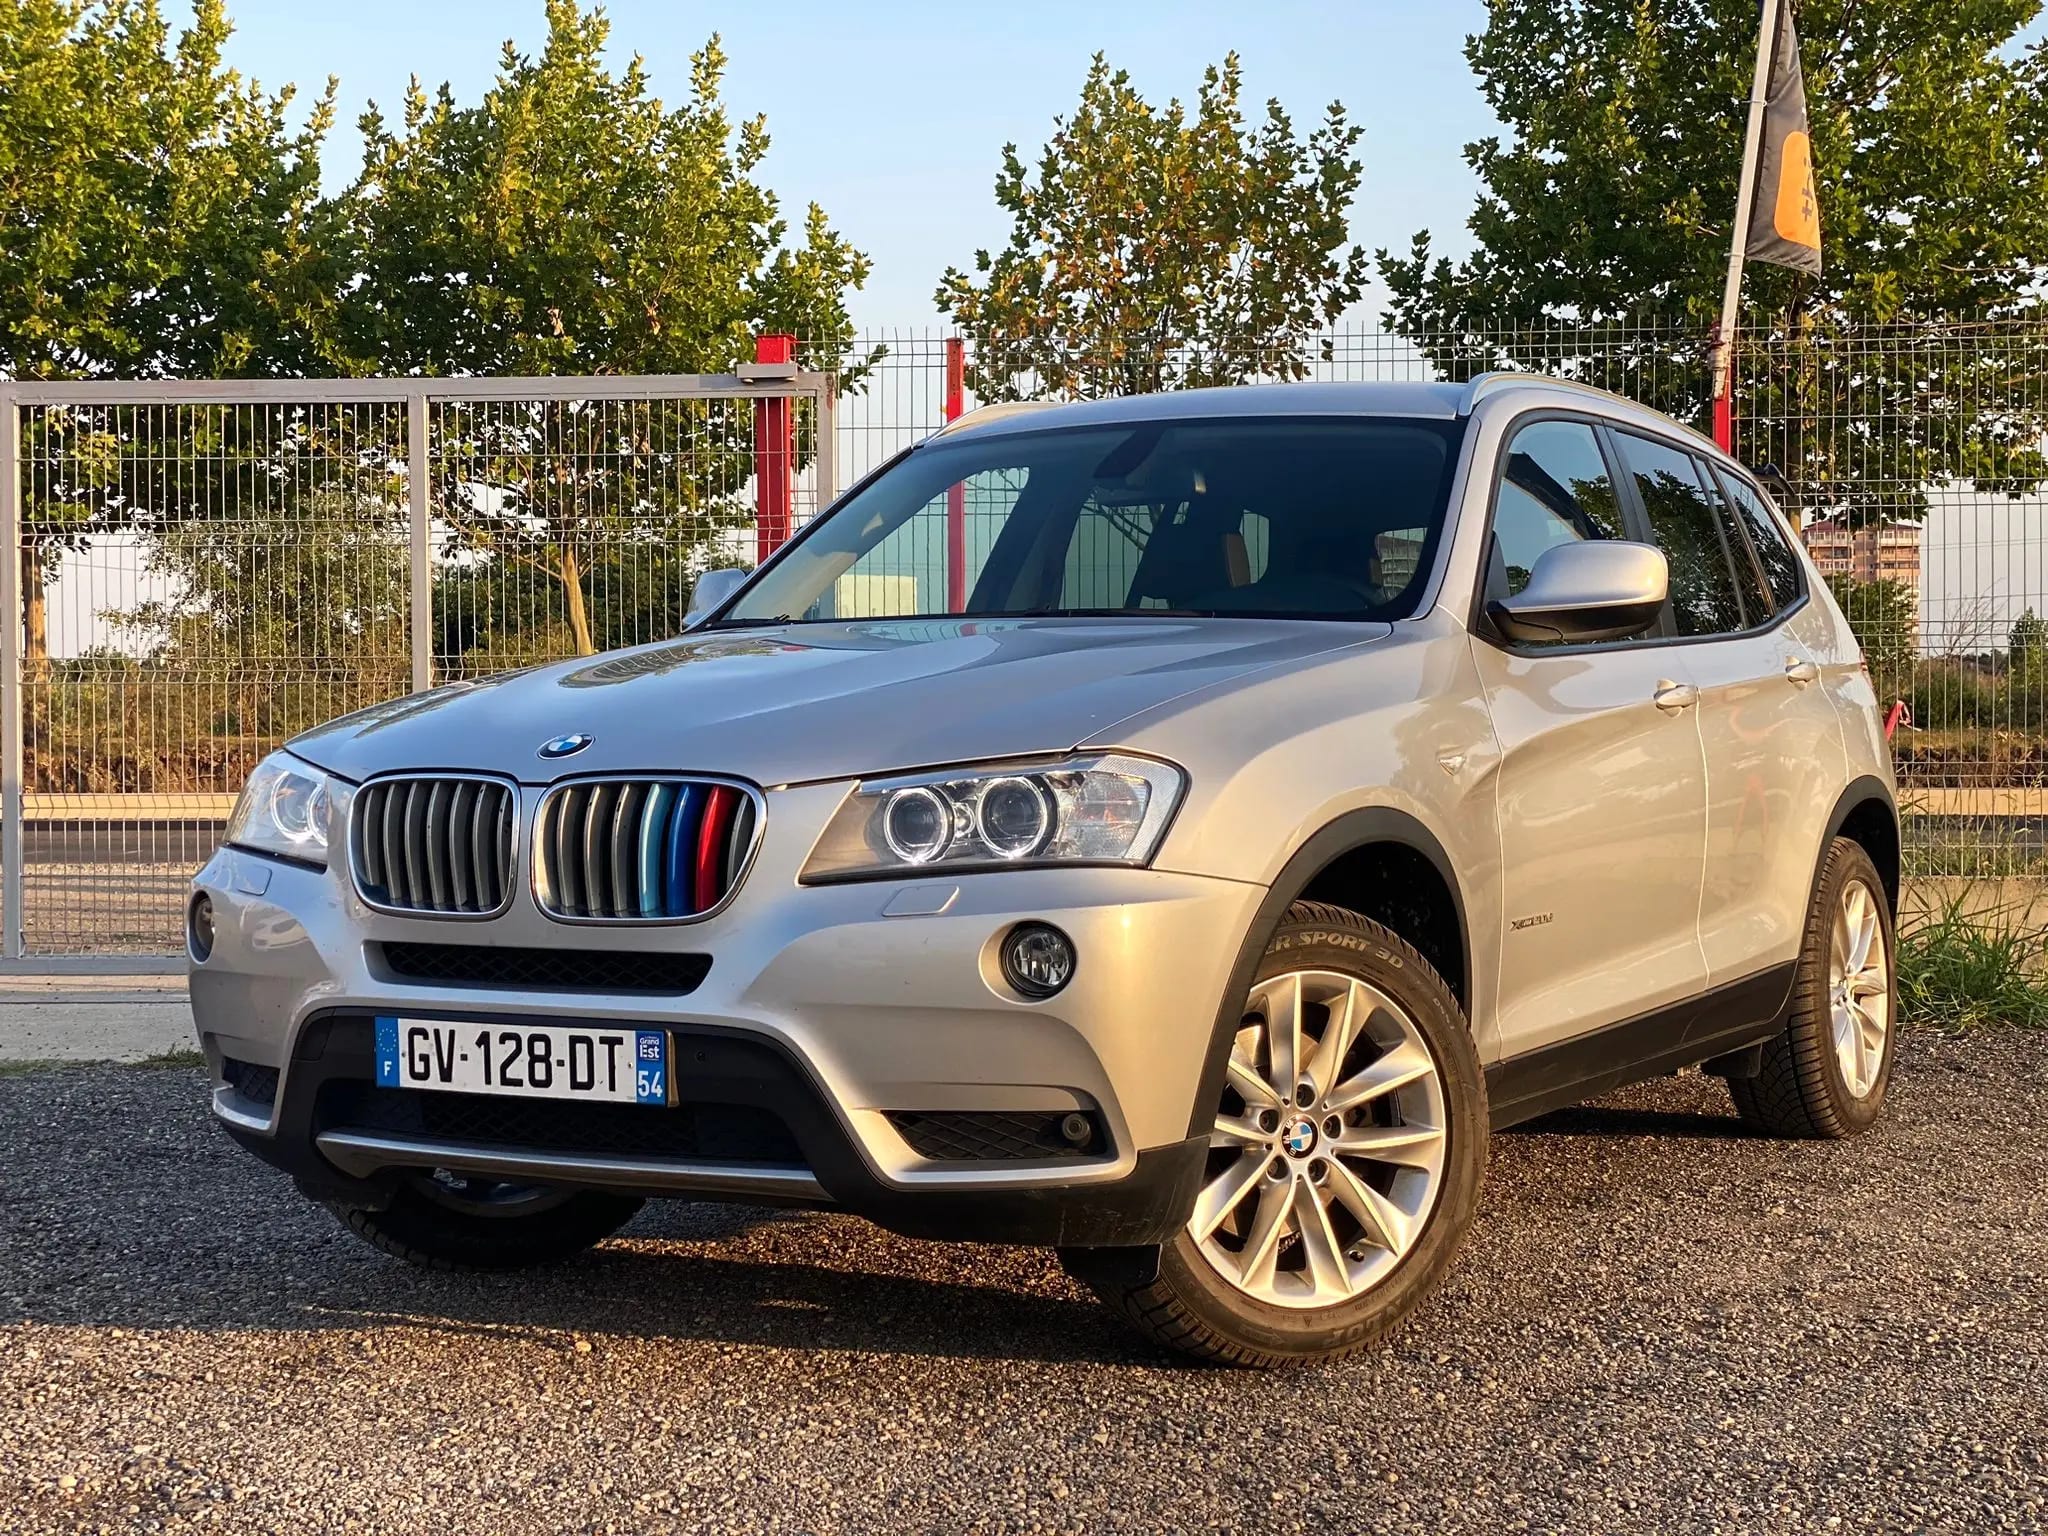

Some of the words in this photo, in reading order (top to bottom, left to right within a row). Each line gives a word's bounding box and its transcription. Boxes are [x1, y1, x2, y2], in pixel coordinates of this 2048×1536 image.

[1298, 931, 1371, 952] SPORT
[1375, 947, 1404, 969] 3D
[639, 1037, 660, 1046] Grand
[639, 1045, 660, 1059] Est
[383, 1060, 392, 1077] F
[407, 1026, 624, 1092] GV-128-DT
[637, 1070, 663, 1098] 54
